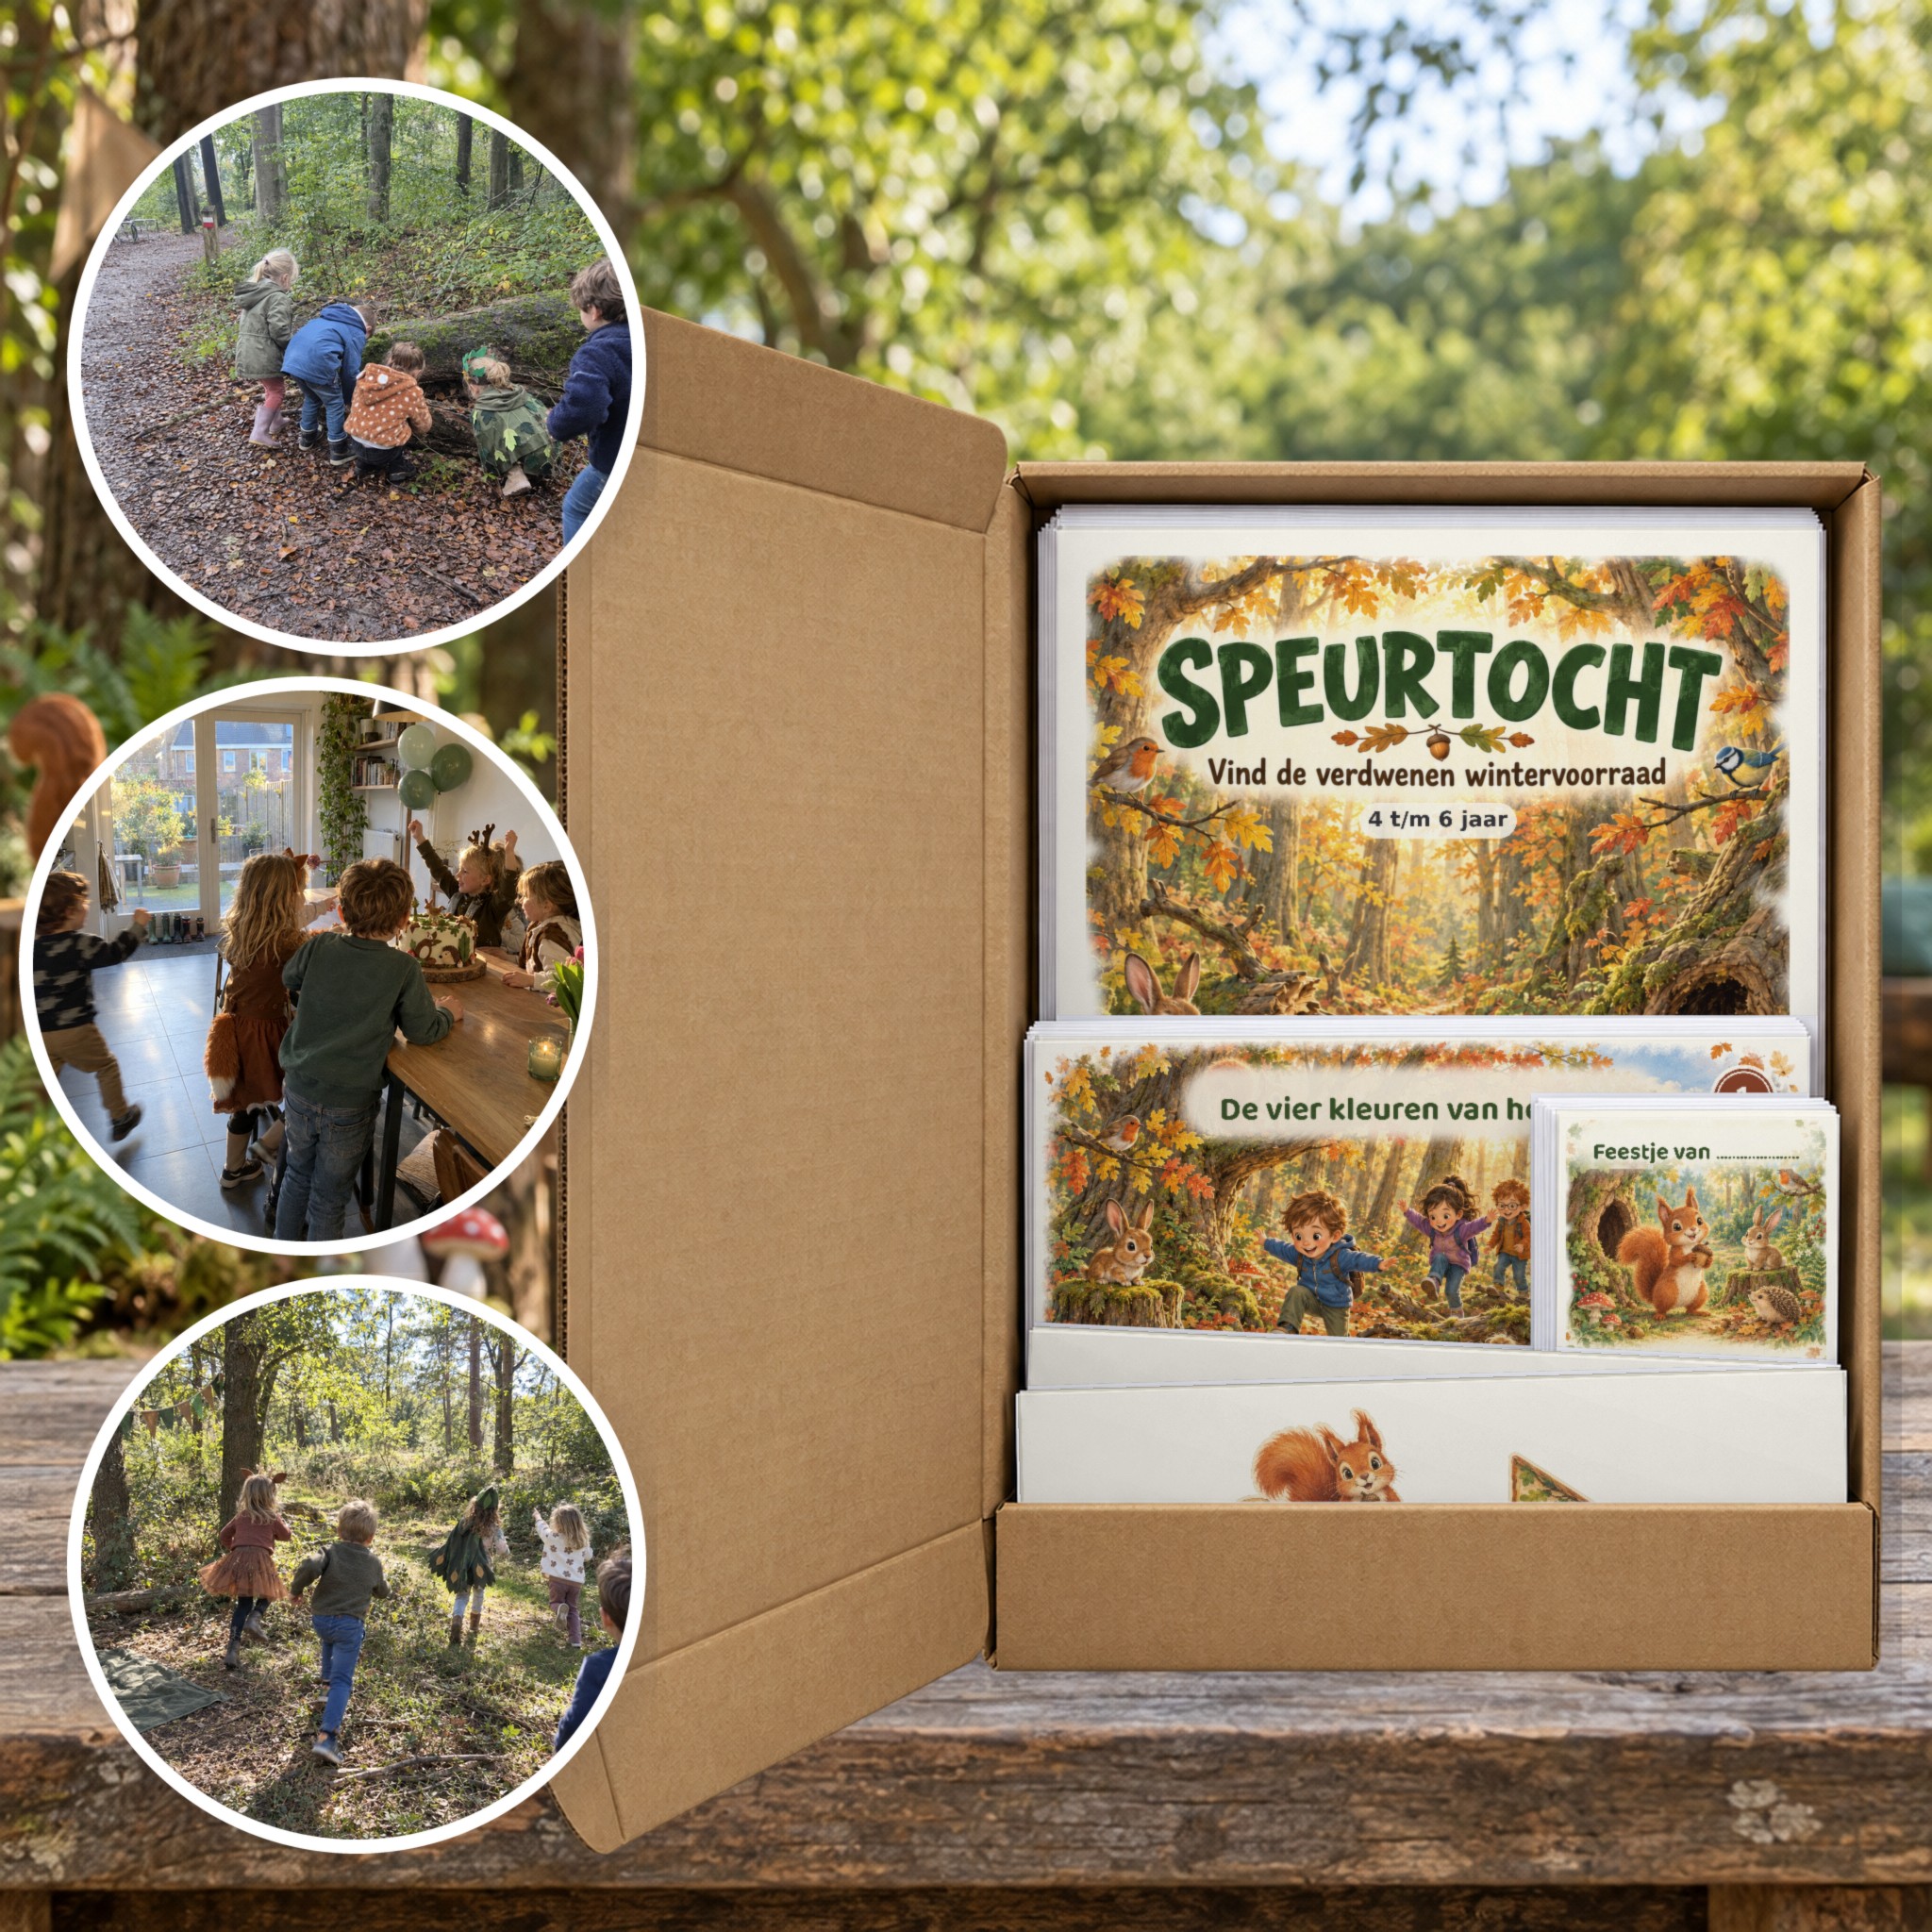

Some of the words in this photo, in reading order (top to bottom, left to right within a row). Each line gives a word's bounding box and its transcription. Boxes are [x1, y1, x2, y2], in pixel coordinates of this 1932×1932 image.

[1157, 630, 1723, 749] SPEURTOCHT
[1208, 758, 1267, 786] Vind
[1276, 758, 1307, 786] de
[1316, 758, 1455, 787] verdwenen
[1465, 758, 1666, 787] wintervoorraad
[1368, 810, 1383, 827] 4
[1390, 810, 1430, 830] t/m
[1439, 809, 1453, 828] 6
[1459, 809, 1508, 832] jaar
[1221, 1098, 1258, 1121] De
[1265, 1095, 1323, 1121] vier
[1329, 1097, 1439, 1121] kleuren
[1446, 1102, 1498, 1121] van
[1593, 1142, 1669, 1164] Feestje
[1673, 1146, 1710, 1160] van
